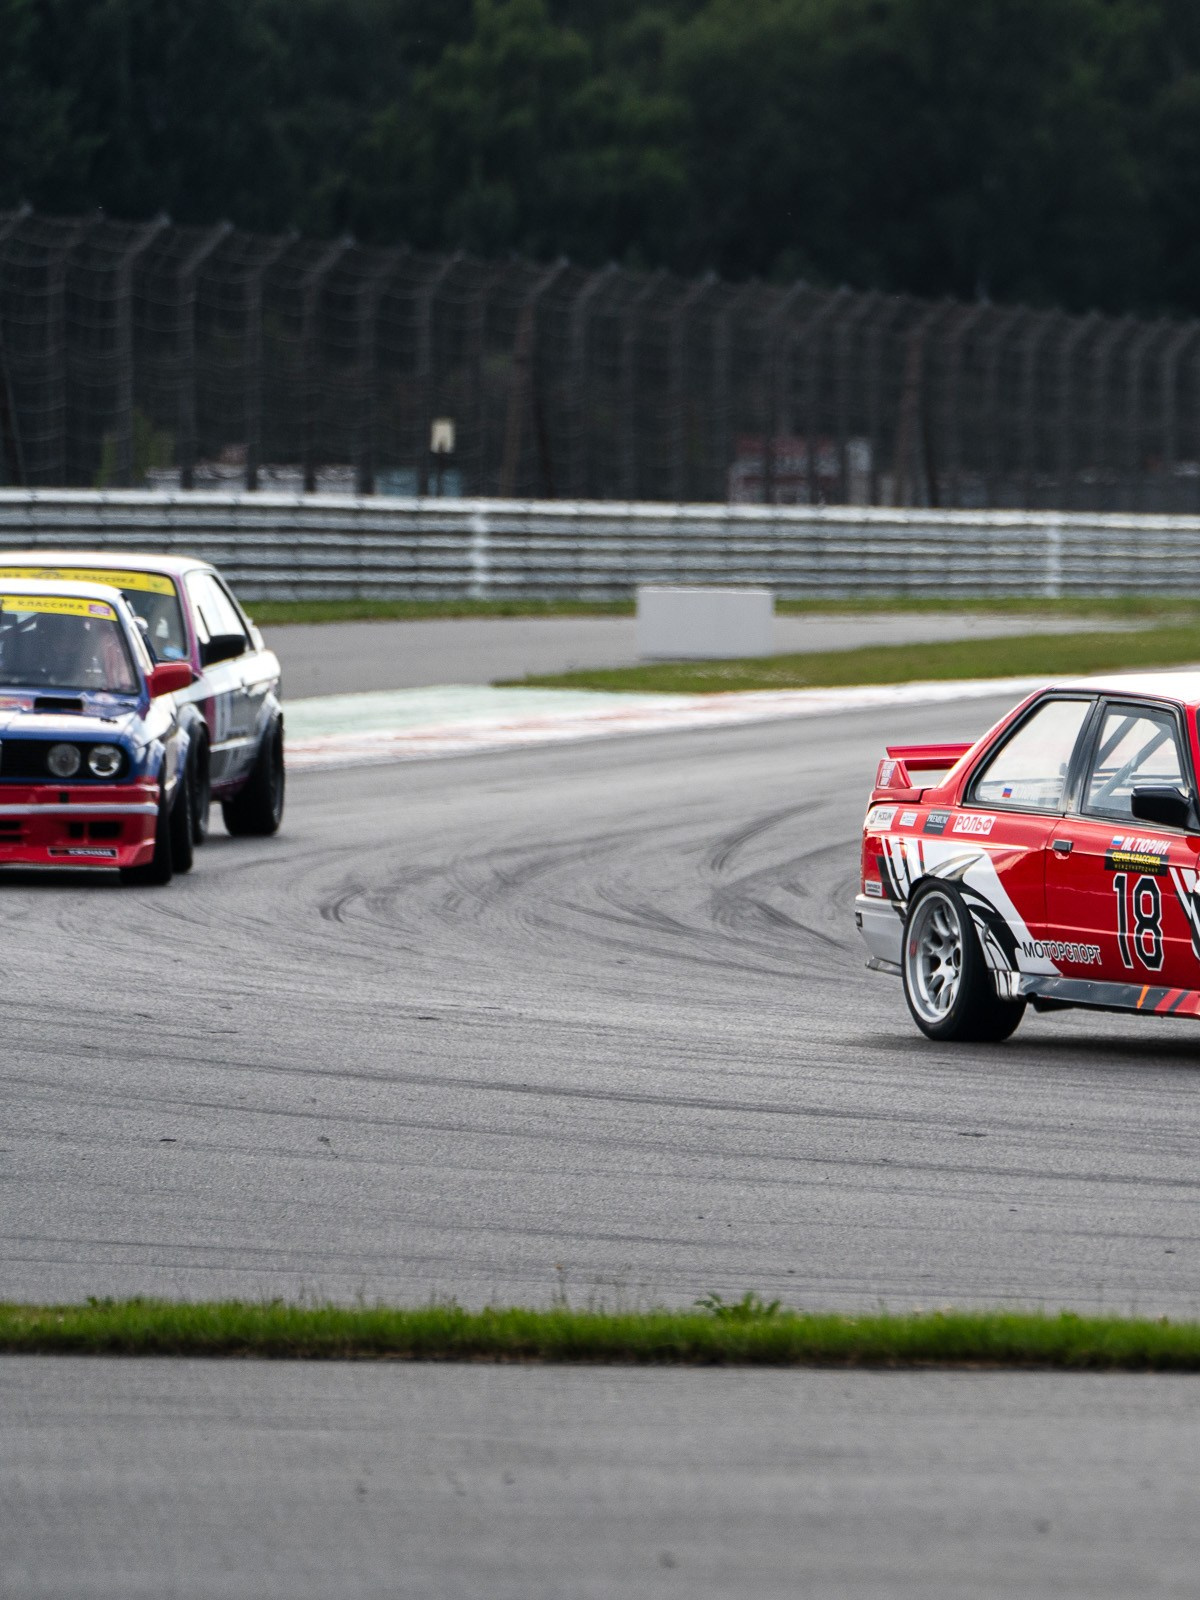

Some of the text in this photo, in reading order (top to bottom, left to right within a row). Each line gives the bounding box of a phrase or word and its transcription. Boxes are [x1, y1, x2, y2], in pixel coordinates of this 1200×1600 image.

[18, 601, 83, 609] КЛАССИКА
[955, 815, 992, 832] РОЛЬФ
[1113, 872, 1164, 971] 18
[1022, 941, 1102, 965] МОТОРСПОРТ
